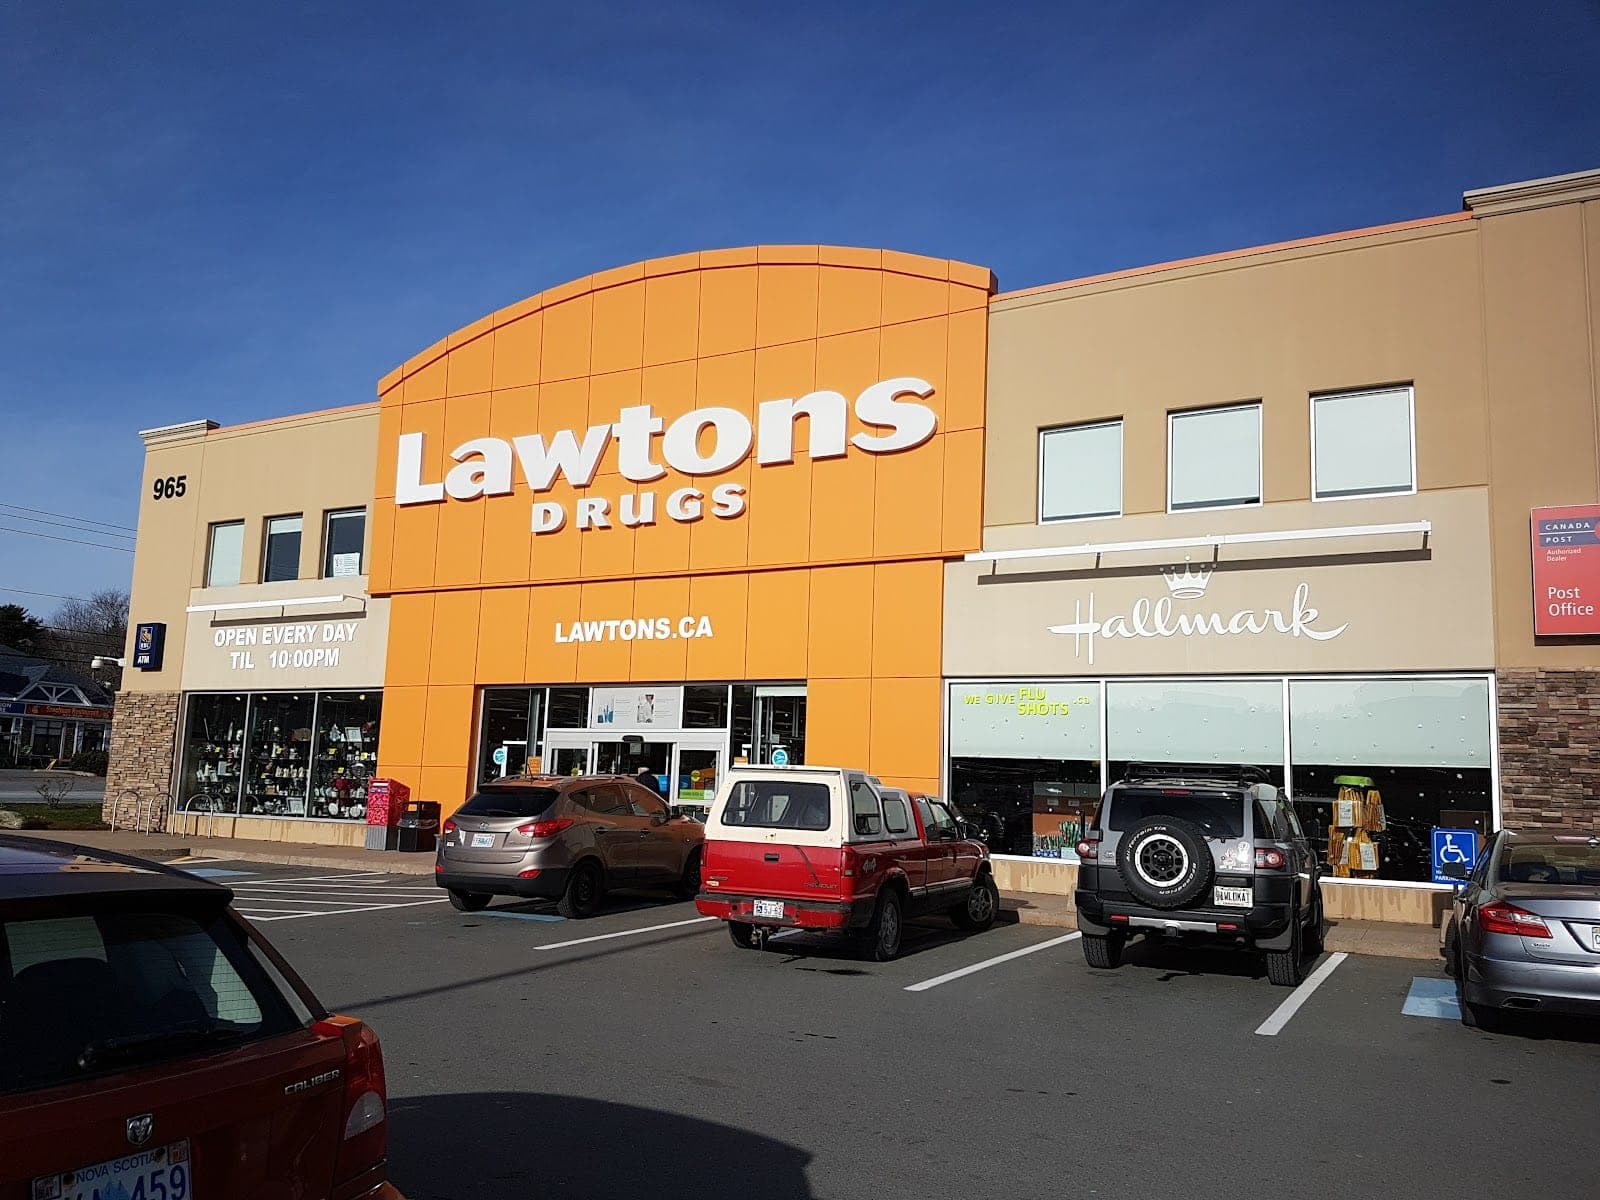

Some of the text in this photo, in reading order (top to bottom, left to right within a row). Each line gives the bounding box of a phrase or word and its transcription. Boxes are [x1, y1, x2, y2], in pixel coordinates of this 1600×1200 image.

[395, 377, 938, 505] Lawtons
[153, 475, 187, 500] 965
[531, 483, 747, 536] DRUGS
[1545, 522, 1591, 531] CANADA
[1546, 547, 1582, 555] Authorized
[1548, 586, 1581, 600] Post
[1548, 602, 1594, 617] Office
[214, 622, 358, 647] OPEN EVERY DAY
[554, 616, 714, 643] LAWTONS.CA
[1047, 582, 1350, 665] Hallmark
[137, 656, 150, 664] ATM
[230, 648, 340, 670] TIL 10:00PM
[964, 695, 981, 704] WE
[984, 694, 1015, 704] GIVE
[1018, 687, 1047, 701] FLU
[1017, 703, 1069, 716] SHOTS
[284, 1069, 340, 1096] CALIBER
[75, 1165, 110, 1184] NOVA
[113, 1151, 157, 1174] SCOTIA
[131, 1164, 186, 1200] 459
